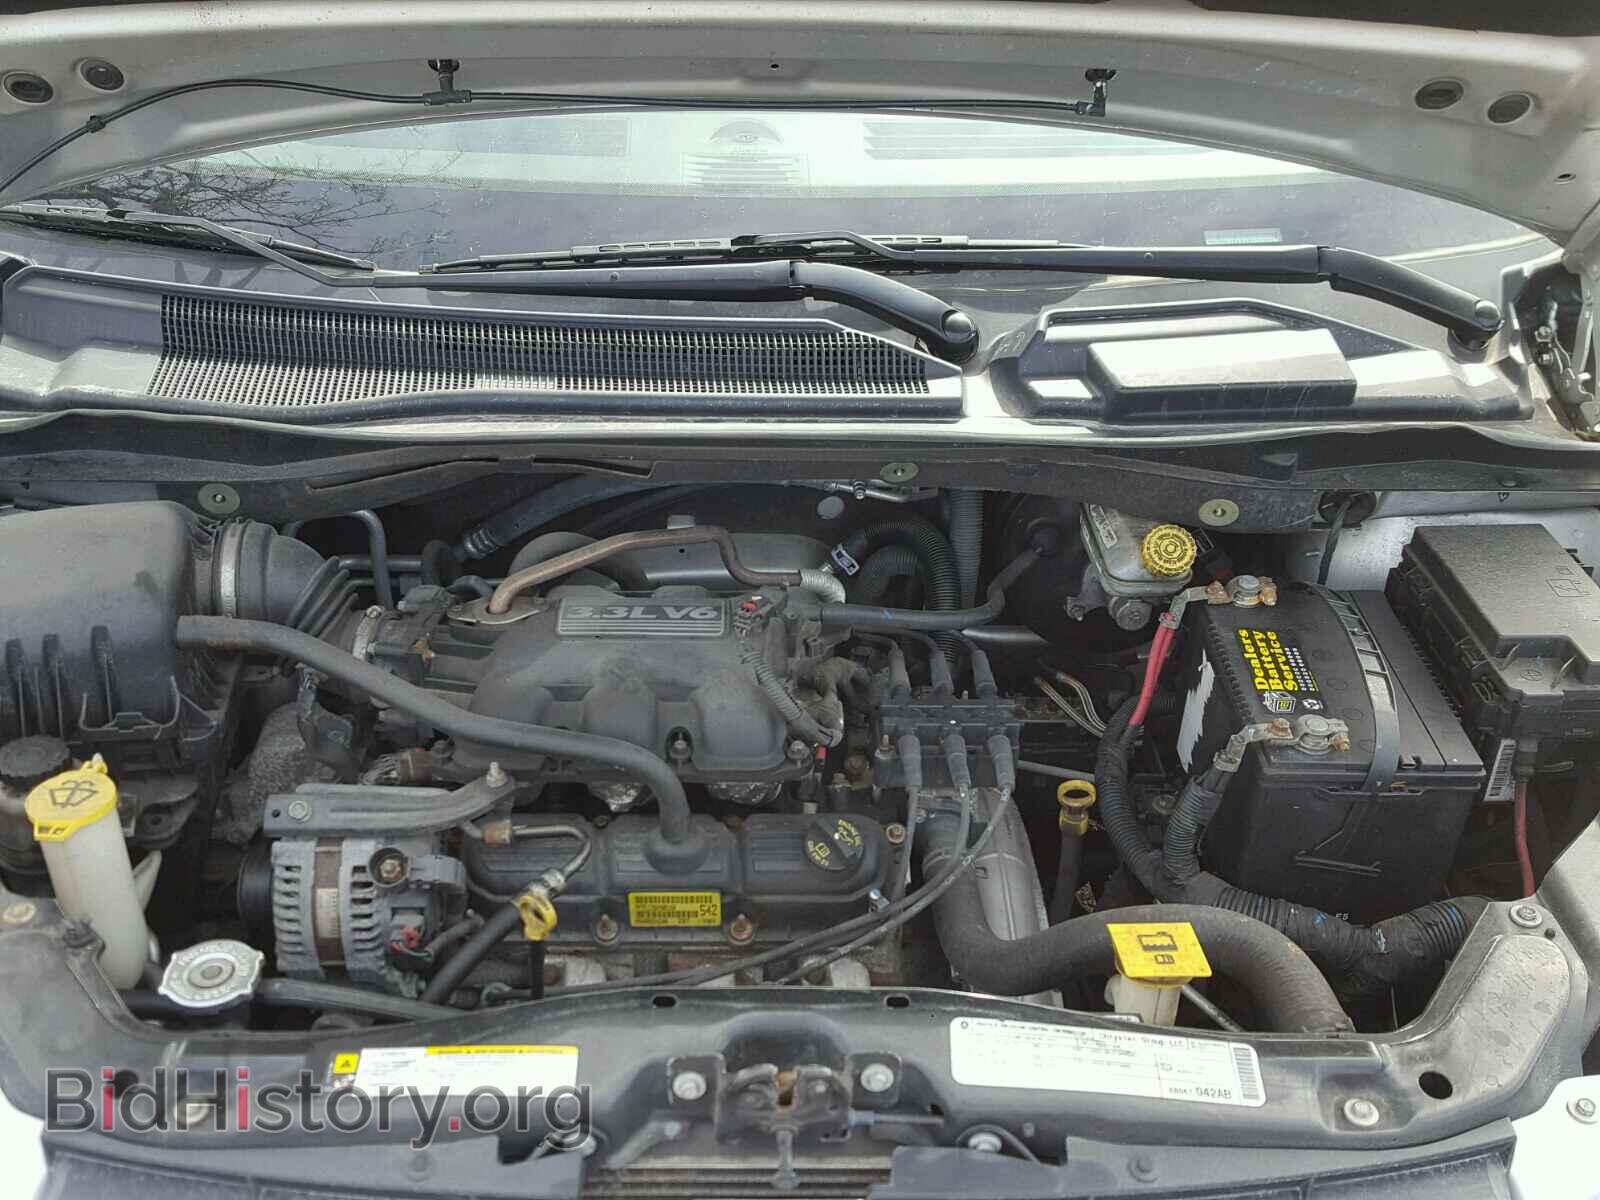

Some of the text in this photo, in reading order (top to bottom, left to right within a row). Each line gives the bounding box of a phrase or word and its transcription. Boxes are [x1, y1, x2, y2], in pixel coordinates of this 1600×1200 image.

[567, 606, 718, 619] 3.3L V6
[1239, 629, 1269, 690] Dealers
[1253, 631, 1284, 690] Battery
[1267, 631, 1298, 691] Service
[699, 903, 718, 917] 542
